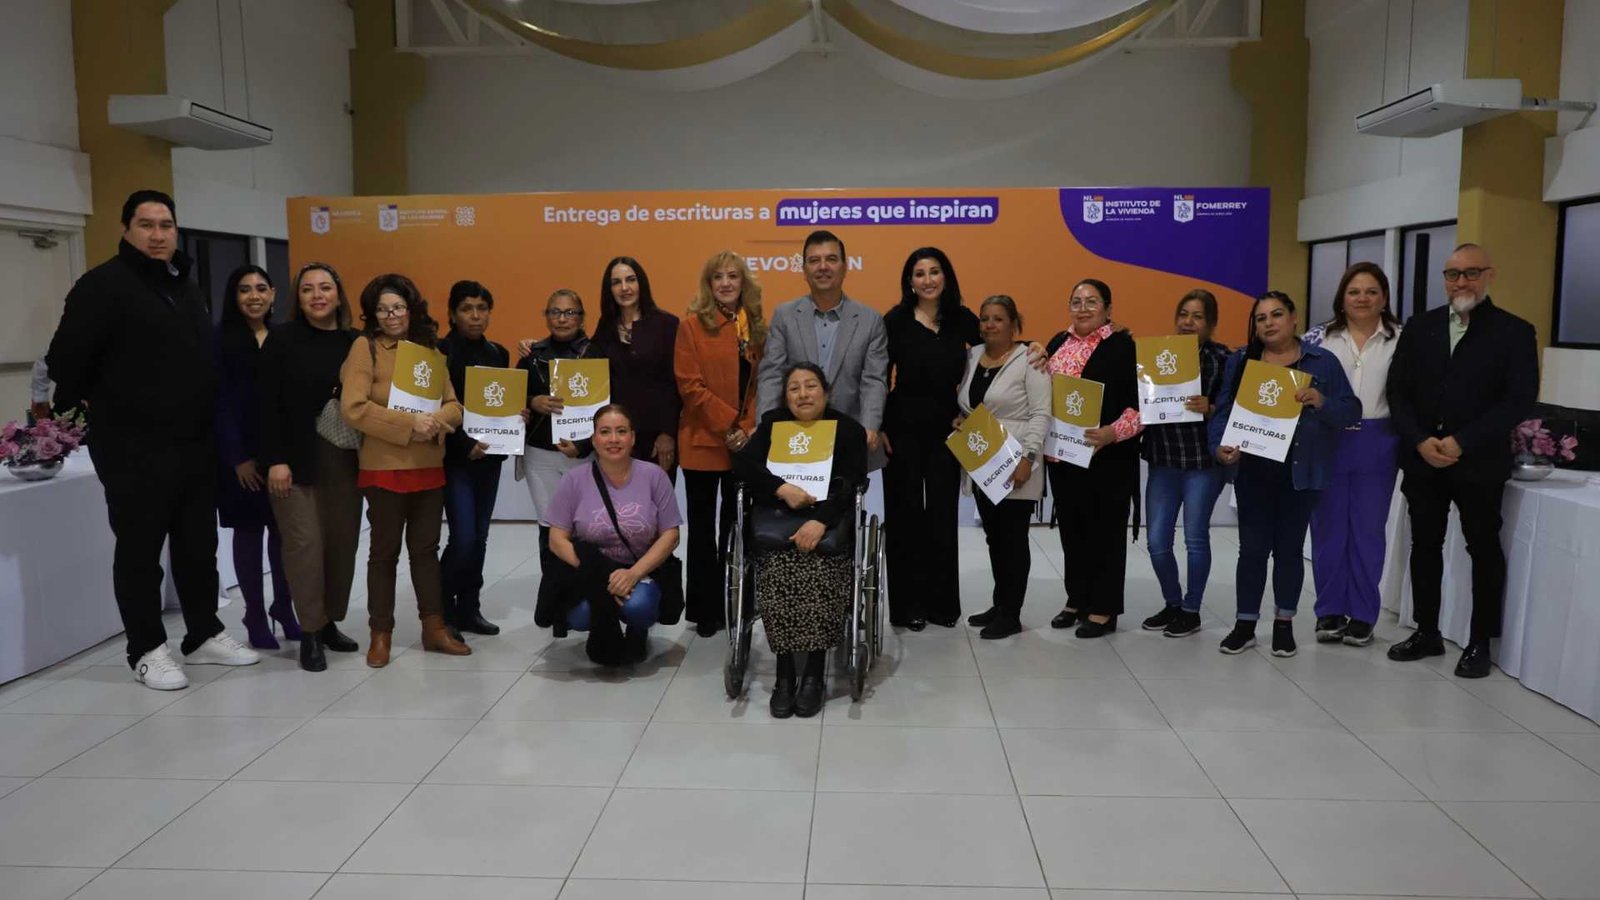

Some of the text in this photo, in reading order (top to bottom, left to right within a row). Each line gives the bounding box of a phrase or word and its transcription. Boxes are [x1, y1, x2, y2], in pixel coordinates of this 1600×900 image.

[1196, 202, 1247, 210] FOMERREY
[544, 200, 993, 226] Entrega de escrituras a mujeres que inspiran
[742, 256, 789, 271] EVO
[557, 417, 594, 425] ESCRITUR
[467, 427, 520, 436] ESCRITURAS
[1232, 421, 1286, 441] ESCRITURAS
[781, 474, 825, 482] CRITURAS
